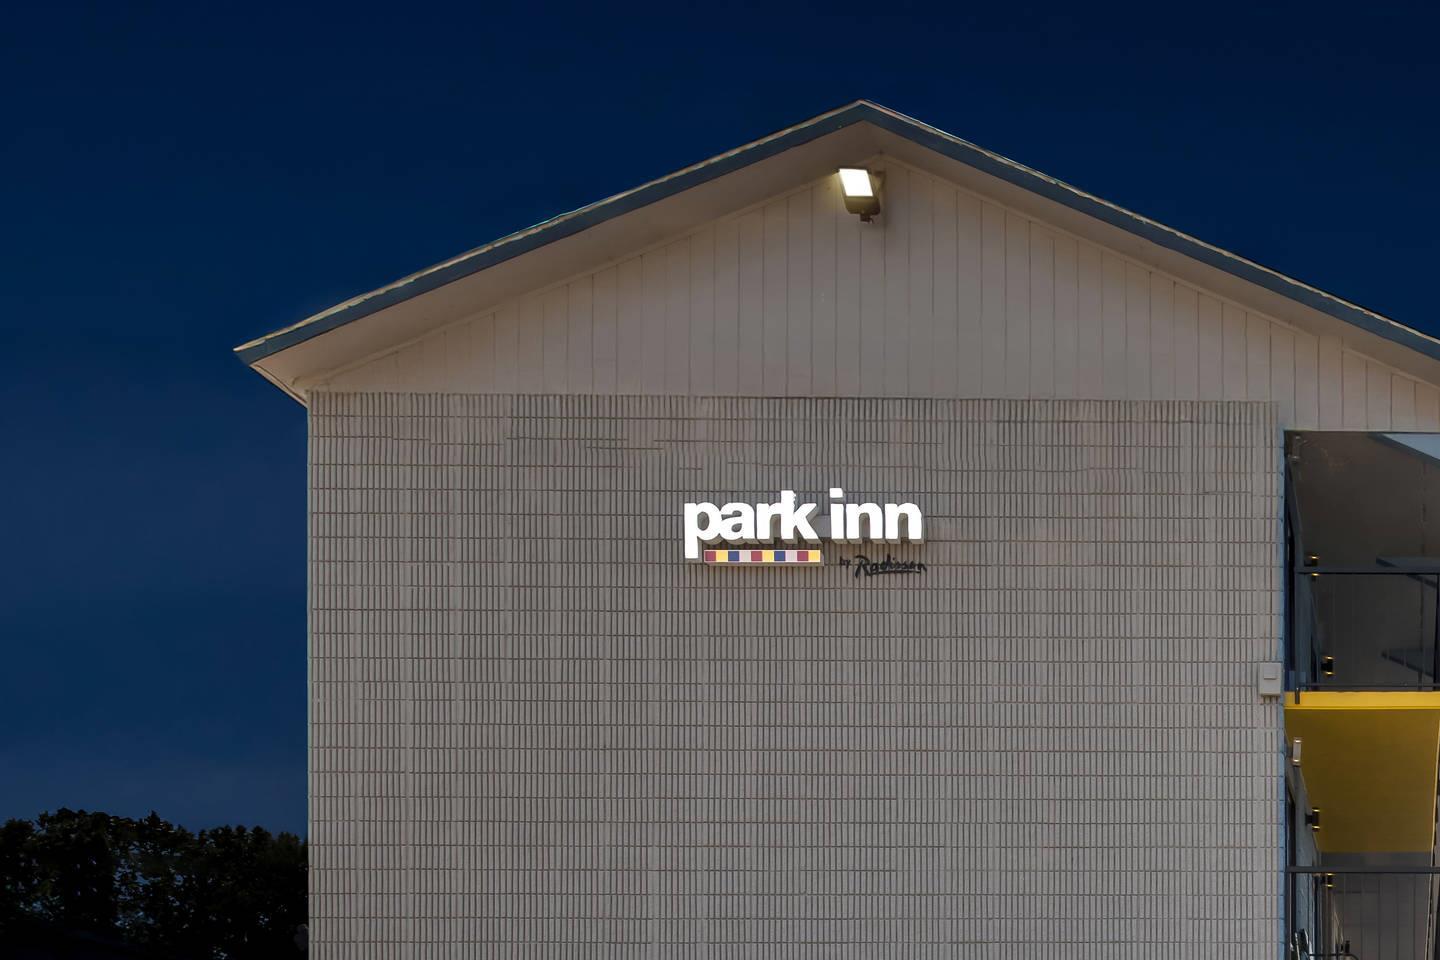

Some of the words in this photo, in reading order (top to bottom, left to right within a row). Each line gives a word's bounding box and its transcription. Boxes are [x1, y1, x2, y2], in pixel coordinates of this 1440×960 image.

[684, 490, 822, 559] park
[829, 487, 923, 541] inn
[839, 556, 851, 569] by
[854, 554, 928, 578] Radisson
